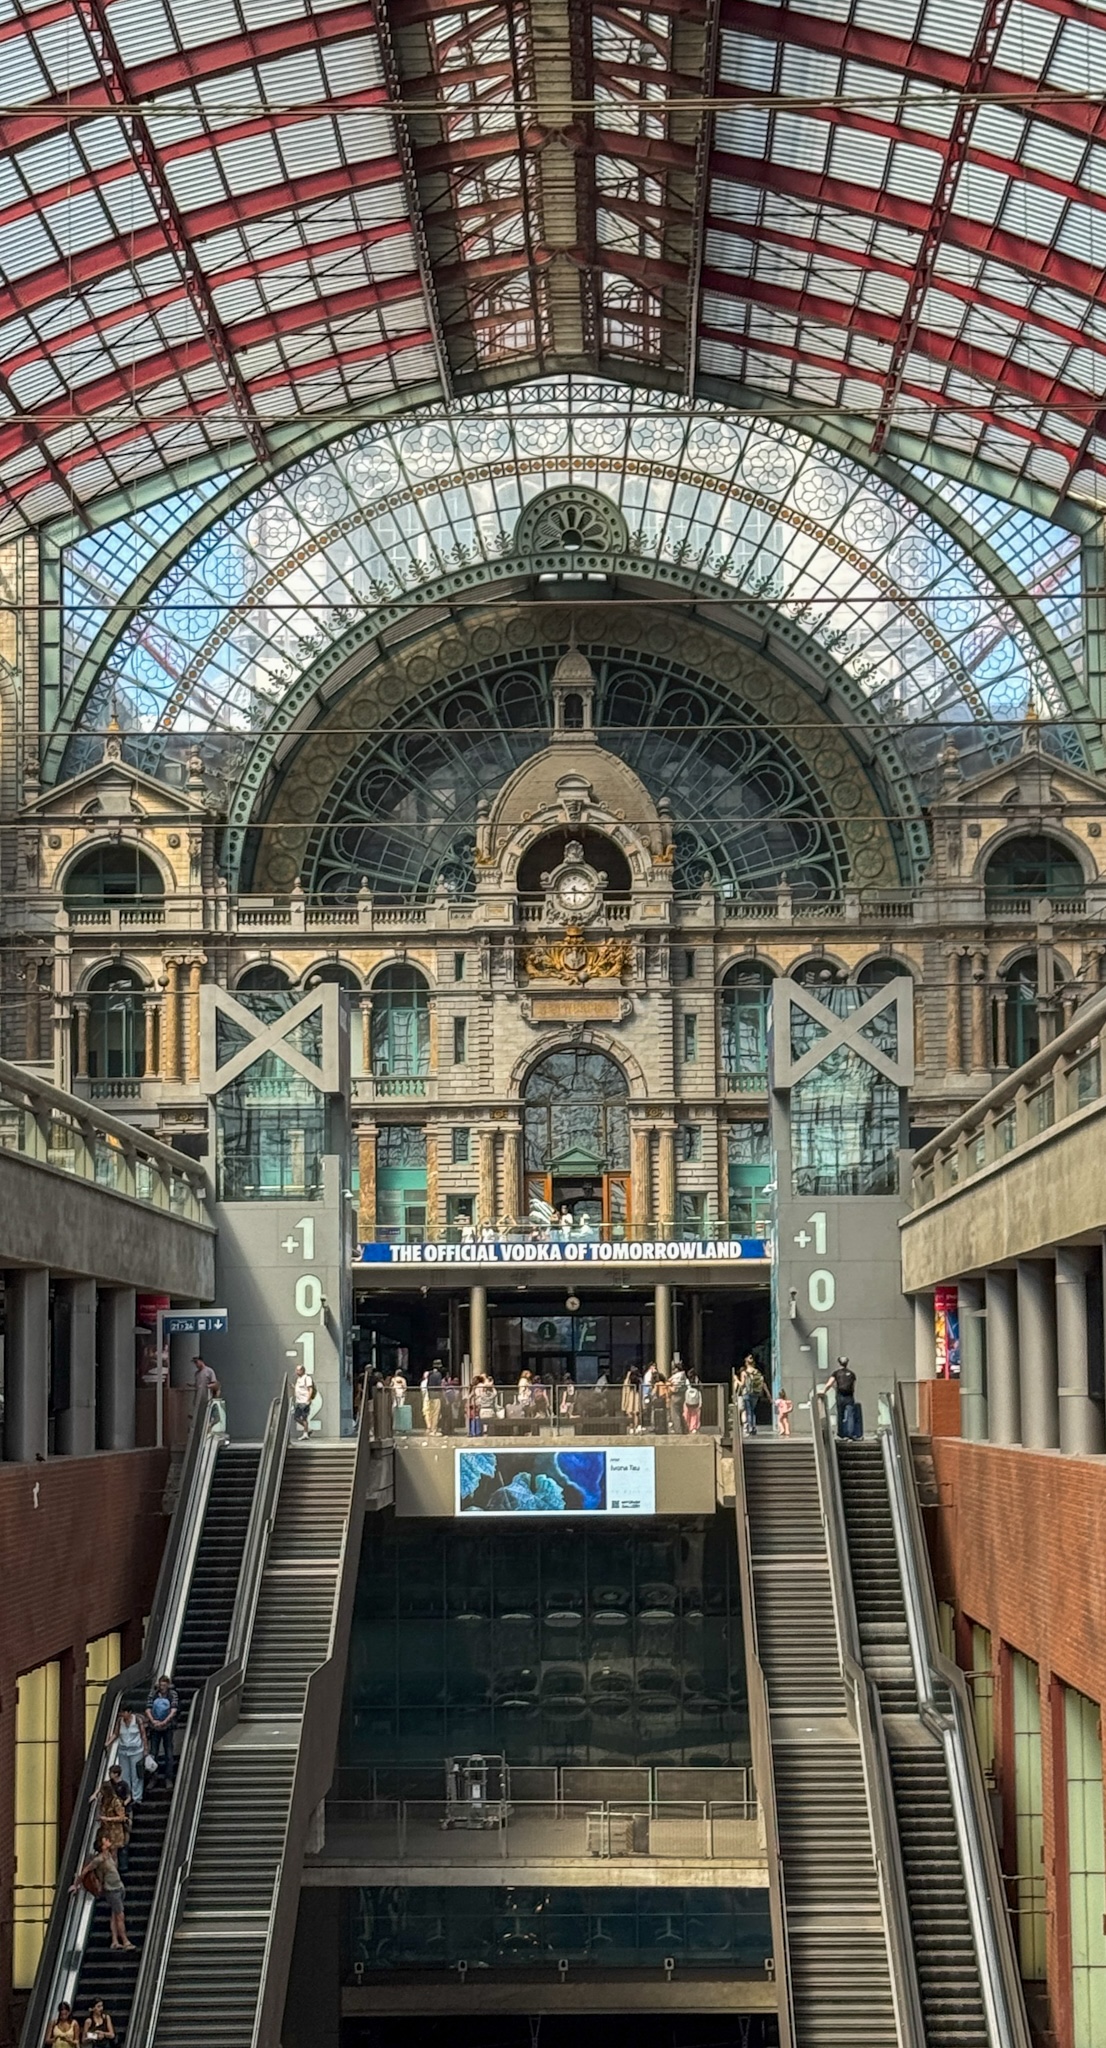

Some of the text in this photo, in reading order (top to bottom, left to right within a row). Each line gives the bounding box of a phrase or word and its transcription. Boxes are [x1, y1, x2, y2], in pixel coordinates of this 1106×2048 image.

[281, 1216, 315, 1260] +1
[389, 1241, 742, 1261] THE OFFICIAL VODKA OF TOMORROWLAND
[793, 1211, 827, 1255] +1
[295, 1274, 323, 1317] 0
[808, 1269, 836, 1312] 0
[285, 1331, 315, 1375] -1
[799, 1326, 829, 1370] -1
